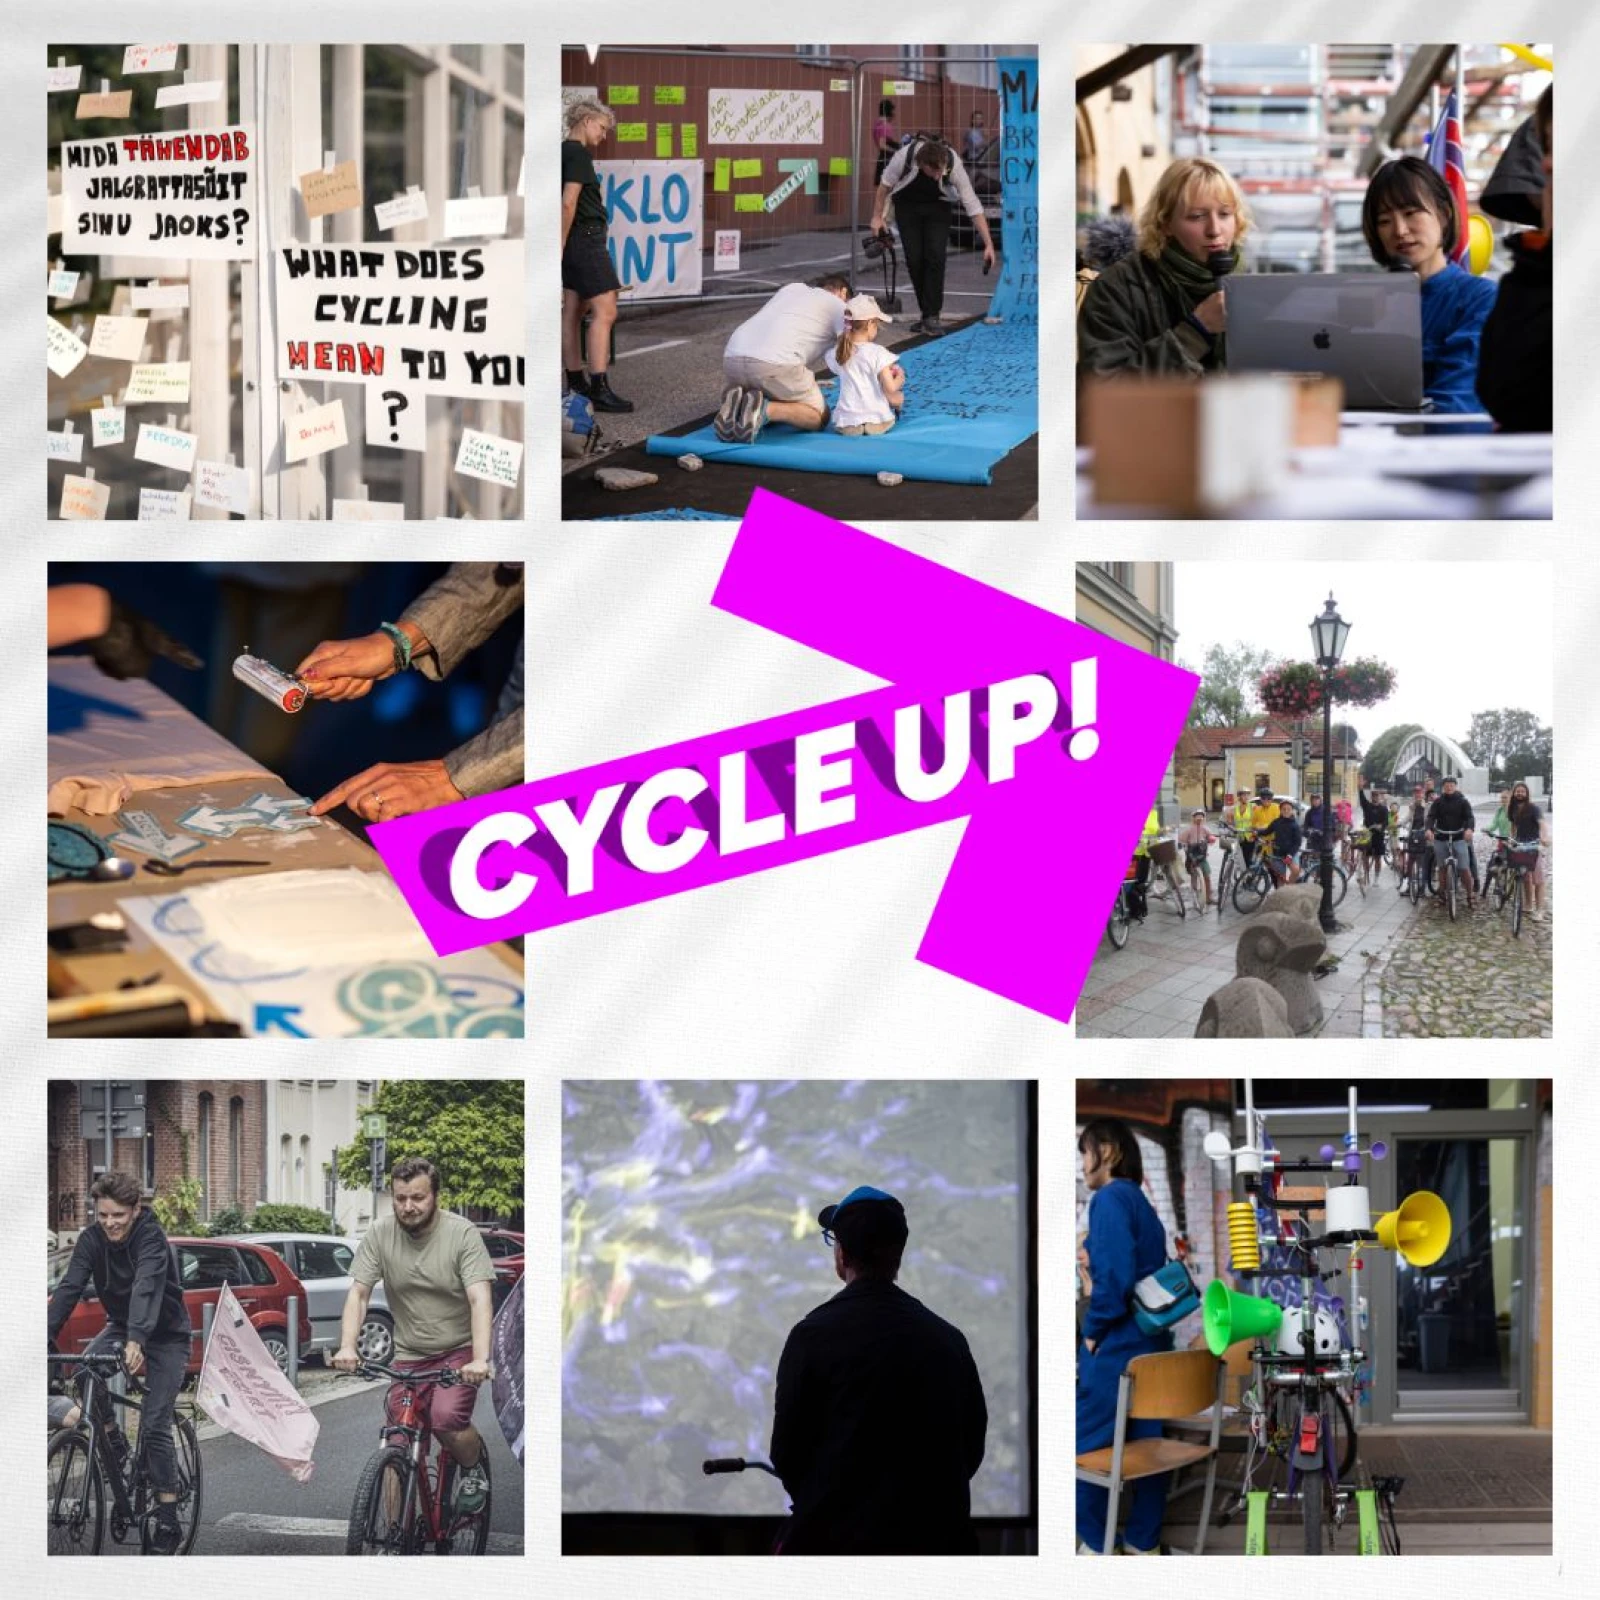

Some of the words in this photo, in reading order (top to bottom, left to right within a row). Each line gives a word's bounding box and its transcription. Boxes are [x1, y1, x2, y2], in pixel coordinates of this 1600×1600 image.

[67, 142, 118, 168] MIDA
[122, 131, 250, 162] TÄHENDAB
[86, 166, 247, 201] JALGRATTASÕIT
[596, 172, 690, 225] KLO
[78, 212, 132, 236] SINU
[149, 208, 250, 246] JAOKS?
[283, 248, 385, 279] WHAT
[395, 248, 484, 281] DOES
[315, 295, 488, 333] CYCLING
[287, 341, 385, 376] MEAN
[401, 348, 446, 380] TO
[381, 390, 409, 442] ?
[368, 1118, 380, 1135] P
